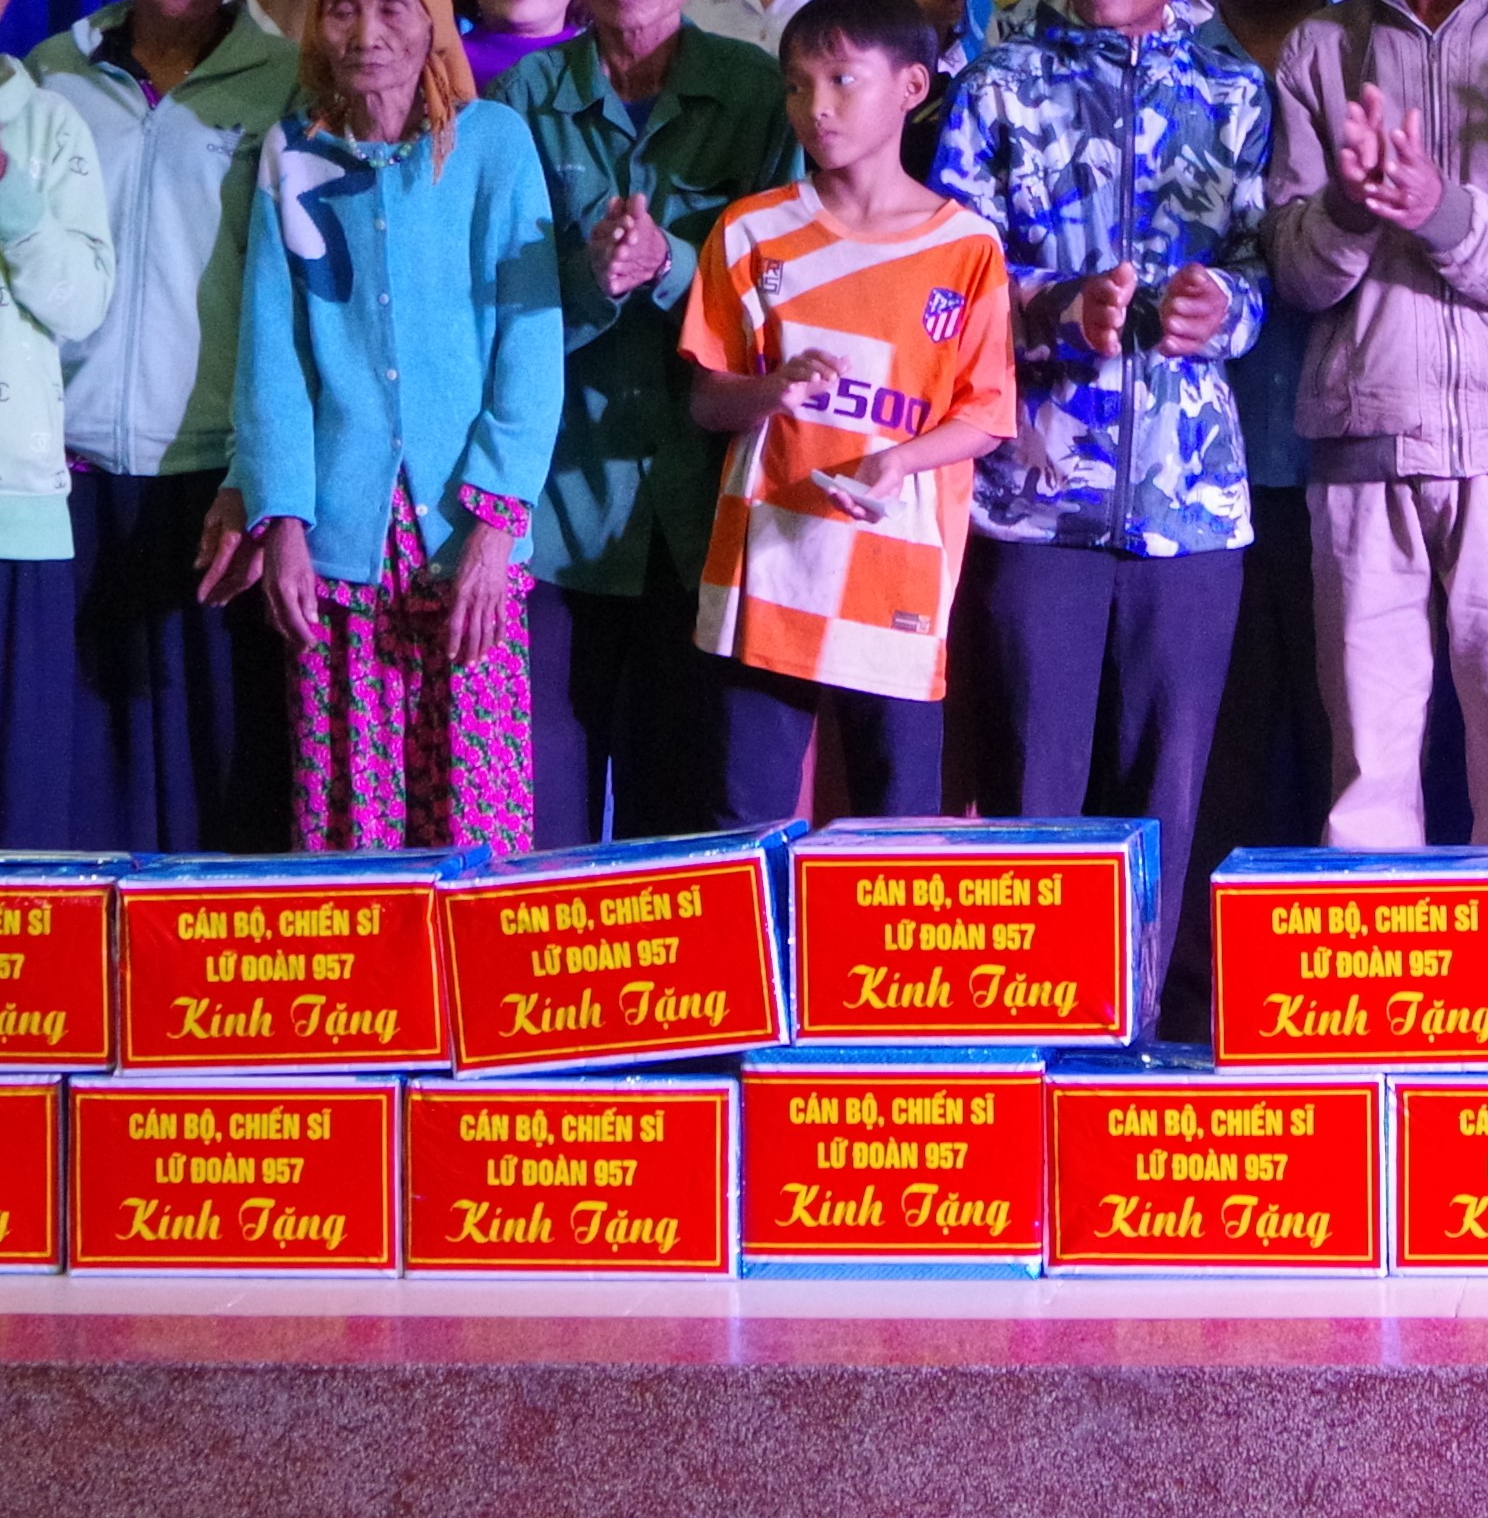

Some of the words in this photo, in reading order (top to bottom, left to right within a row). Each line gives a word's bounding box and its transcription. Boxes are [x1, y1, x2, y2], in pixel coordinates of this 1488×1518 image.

[28, 902, 51, 935] SĨ
[501, 903, 549, 934] CÁN
[556, 898, 594, 933] BỘ,
[600, 887, 671, 925] CHIẾN
[678, 886, 702, 918] SĨ
[1272, 903, 1321, 934] CÁN
[1329, 902, 1368, 939] BỘ,
[1375, 898, 1447, 933] CHIẾN
[1455, 900, 1478, 931] SĨ
[532, 945, 561, 976] LỮ
[566, 940, 631, 973] ĐOÀN
[637, 937, 679, 966] 957
[1301, 947, 1332, 978] LỮ
[1336, 946, 1402, 978] ĐOÀN
[1409, 950, 1452, 977] 957
[500, 989, 602, 1034] Kính
[621, 982, 729, 1028] Tặng
[1257, 994, 1369, 1037] Kính
[129, 1109, 177, 1139] CÁN
[184, 1109, 221, 1144] BỘ,
[230, 1107, 300, 1139] CHIẾN
[307, 1109, 331, 1139] SĨ
[790, 1093, 838, 1124] CÁN
[846, 1093, 884, 1129] BỘ,
[892, 1091, 963, 1124] CHIẾN
[971, 1093, 994, 1124] SĨ
[156, 1153, 186, 1183] LỮ
[191, 1153, 255, 1183] ĐOÀN
[262, 1158, 304, 1183] 957
[818, 1137, 848, 1168] LỮ
[852, 1138, 918, 1168] ĐOÀN
[925, 1143, 968, 1169] 957
[117, 1198, 221, 1240] Kính
[241, 1198, 347, 1249] Tặng
[774, 1183, 884, 1226] Kính
[902, 1183, 1011, 1236] Tặng
